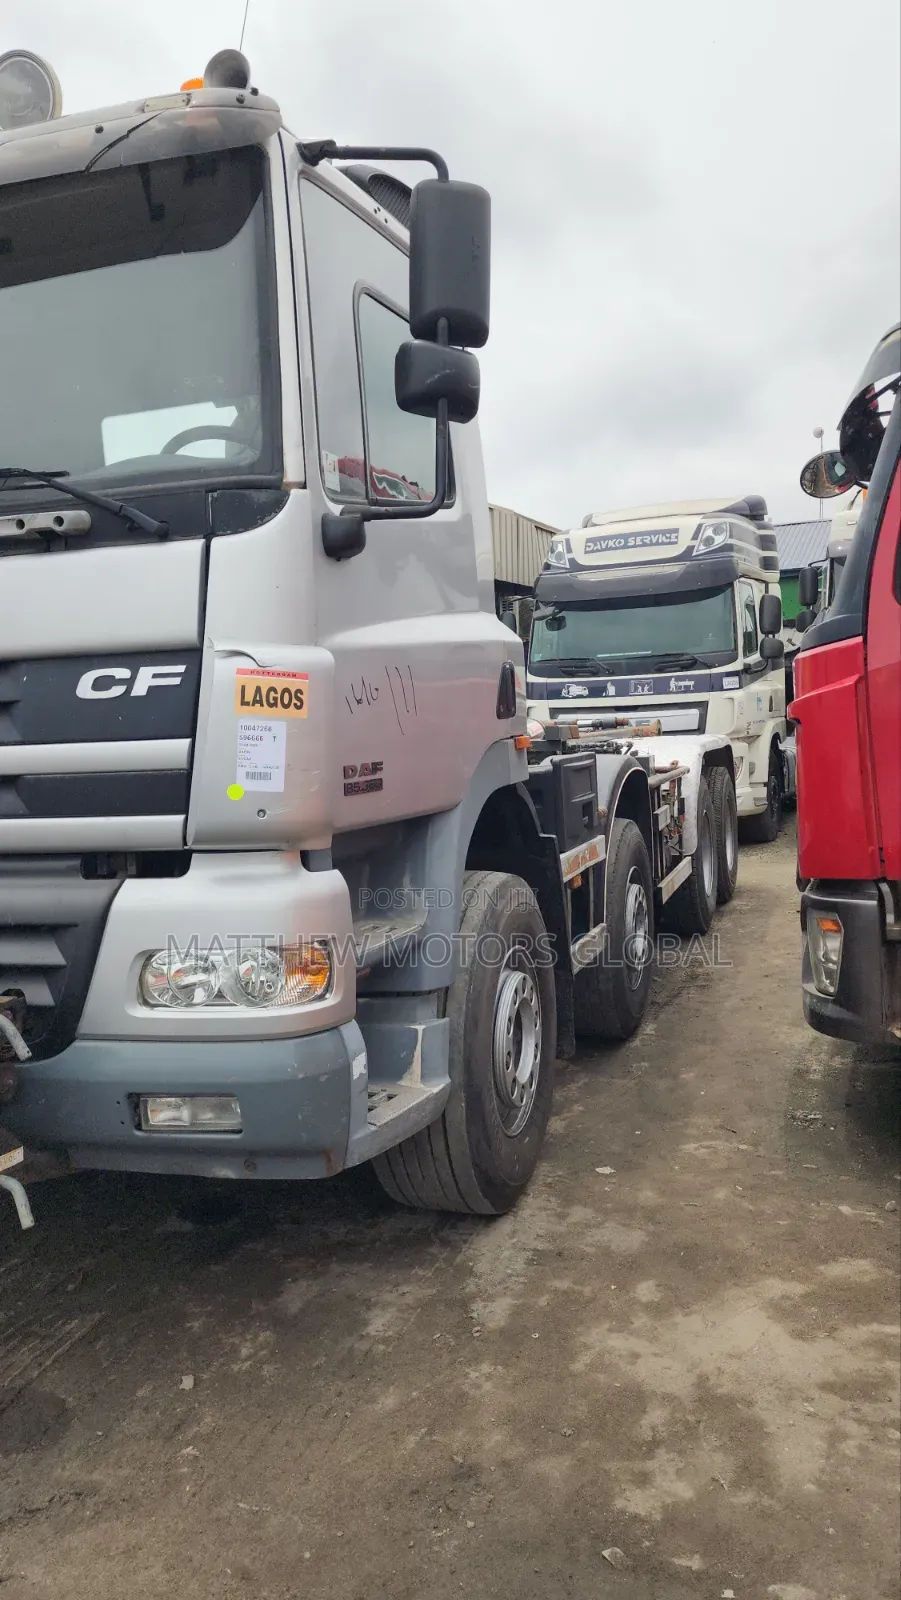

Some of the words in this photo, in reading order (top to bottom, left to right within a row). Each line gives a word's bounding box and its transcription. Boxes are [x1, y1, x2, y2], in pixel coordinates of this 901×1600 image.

[585, 538, 625, 552] DAVKO
[627, 533, 679, 546] SERVICE
[75, 664, 187, 699] CF
[240, 685, 304, 710] LAGOS
[343, 761, 384, 779] DAF
